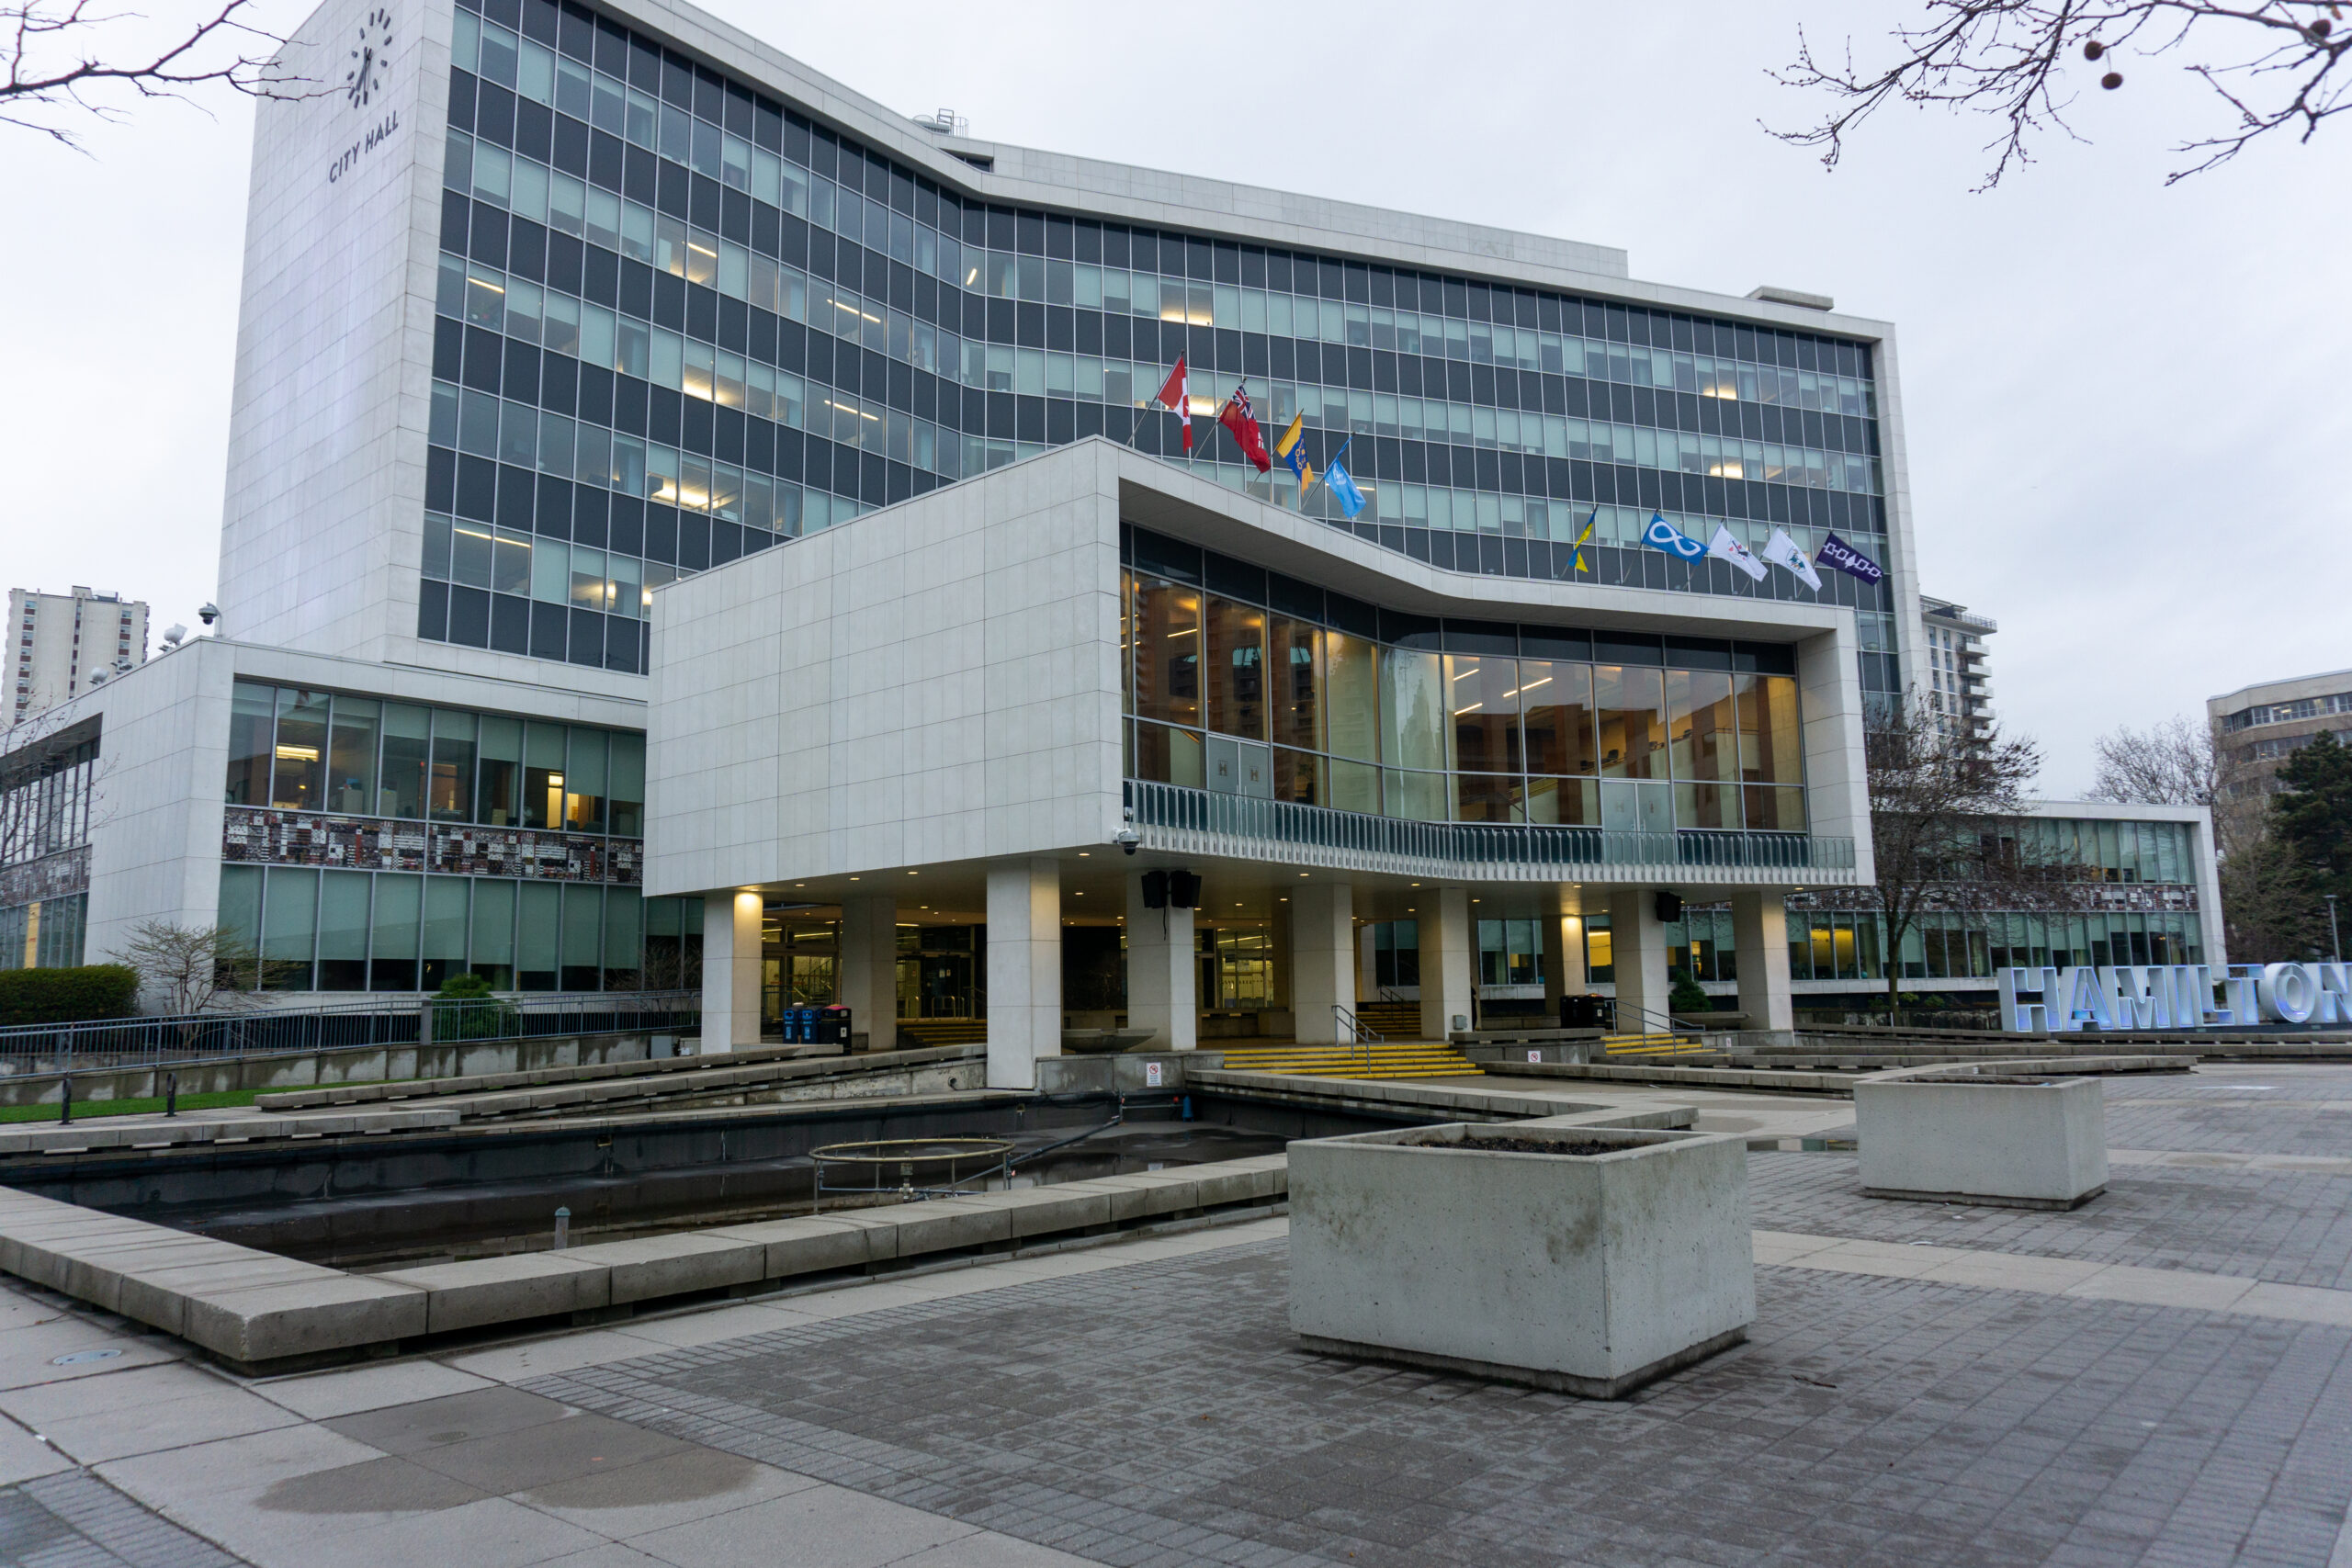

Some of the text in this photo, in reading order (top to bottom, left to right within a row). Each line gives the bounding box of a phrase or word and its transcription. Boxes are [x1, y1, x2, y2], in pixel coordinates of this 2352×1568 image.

[329, 110, 399, 184] CITY HALL
[1997, 962, 2352, 1032] HAMILTON
